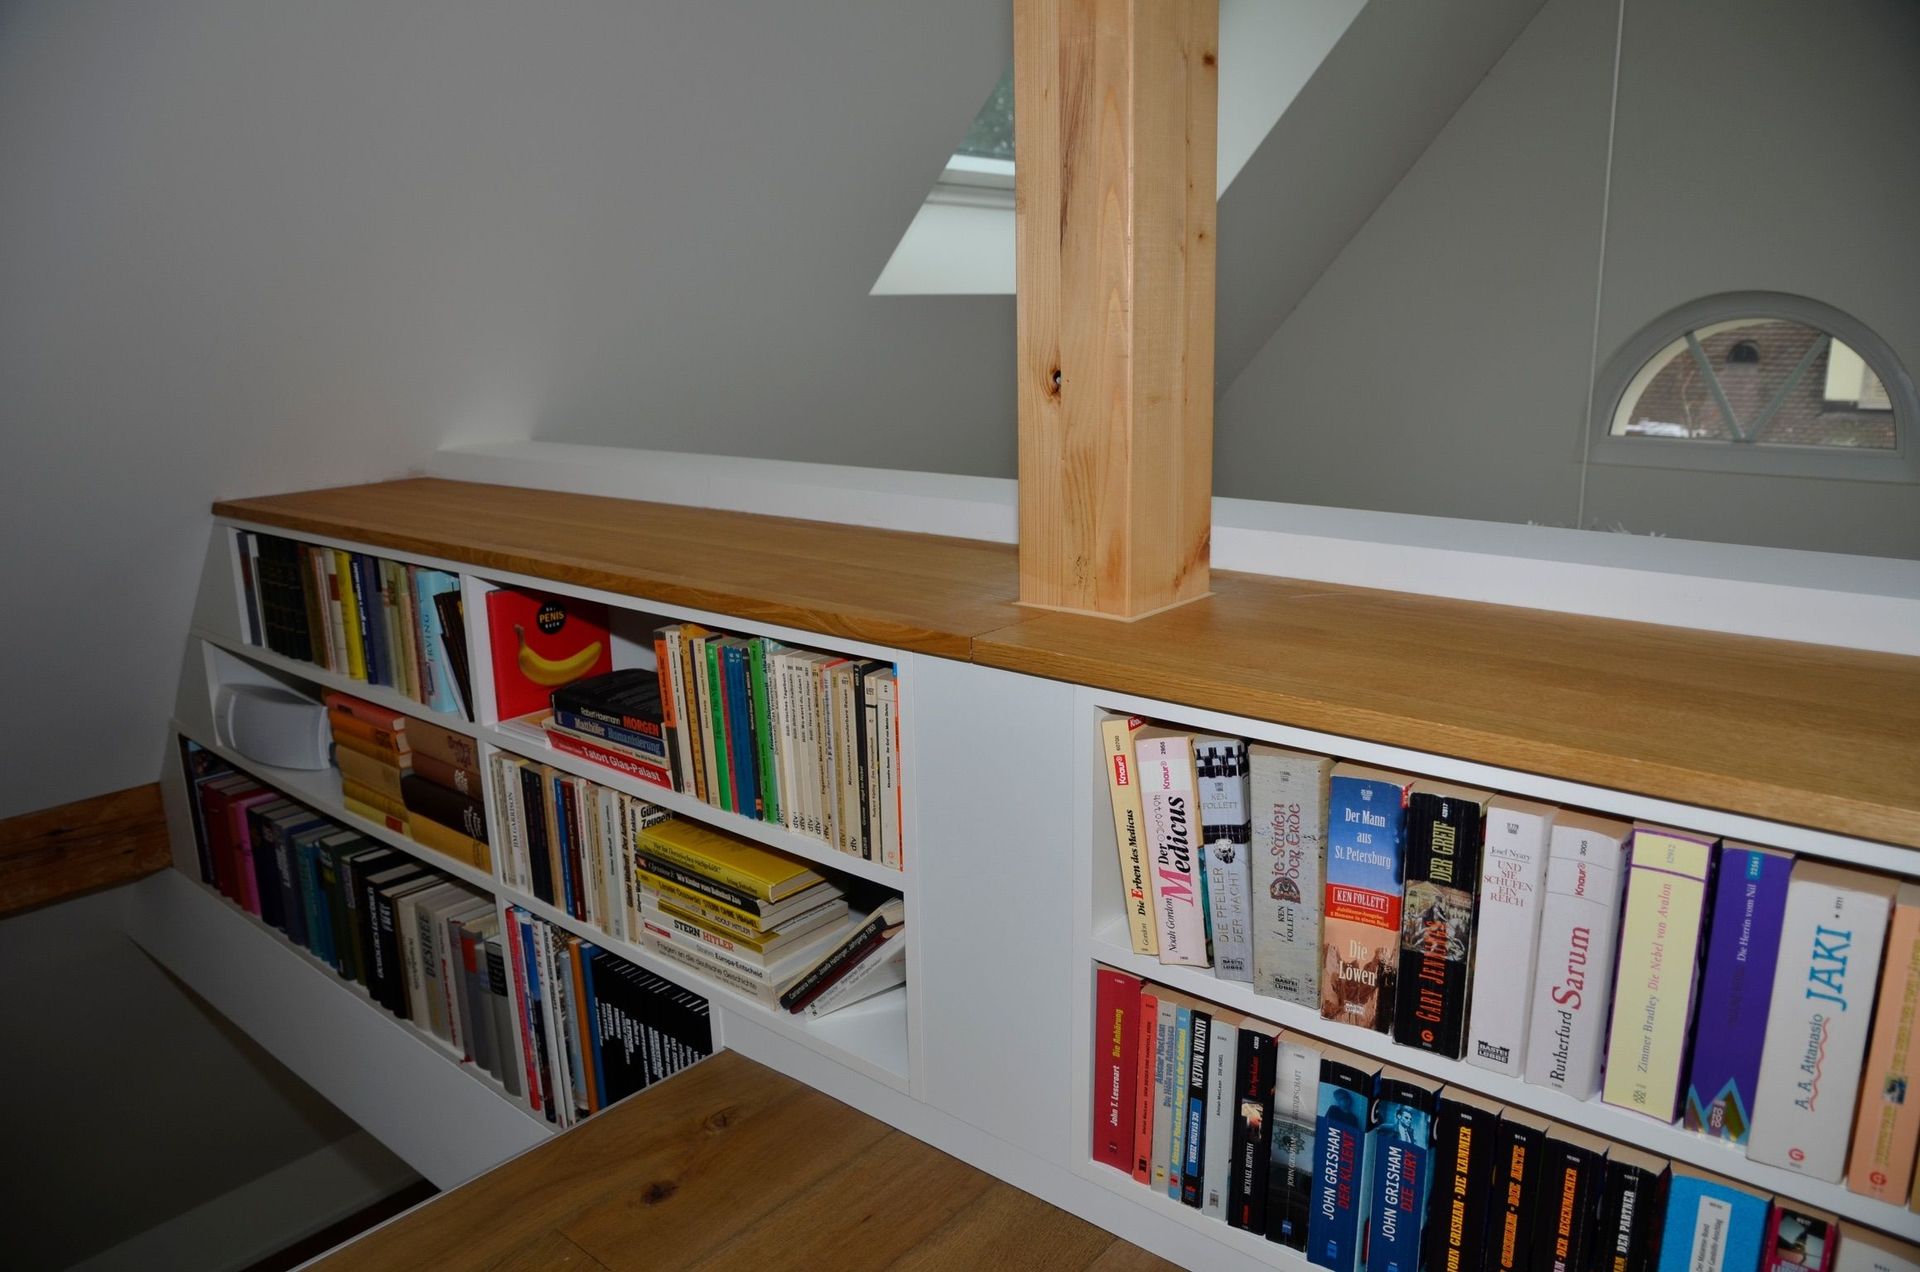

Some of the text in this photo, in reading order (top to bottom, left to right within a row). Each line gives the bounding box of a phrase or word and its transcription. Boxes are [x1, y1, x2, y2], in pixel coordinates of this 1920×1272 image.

[539, 612, 564, 623] PENIS
[623, 716, 658, 737] MORGEN
[582, 747, 608, 764] Tatort
[610, 756, 660, 782] Glas-Palast
[1202, 801, 1238, 810] FOLLETT
[1212, 792, 1228, 800] KEN
[1127, 810, 1137, 848] Medicus
[1345, 808, 1386, 828] Der Mann
[1159, 796, 1194, 907] Medicus
[1357, 832, 1372, 845] aus
[1132, 848, 1140, 860] des
[1158, 844, 1169, 866] Der
[1335, 846, 1392, 870] St. Petersburg
[1498, 860, 1522, 872] UND
[1131, 859, 1144, 900] Erben
[1484, 875, 1533, 892] SCHUFEN
[1502, 870, 1518, 880] SIE
[1336, 890, 1386, 910] KEN FOLLETT
[1490, 892, 1524, 908] REICH
[1499, 886, 1516, 896] EIN
[1658, 883, 1672, 919] Avalon
[1746, 884, 1757, 899] Nil
[1138, 900, 1146, 916] Die
[1214, 867, 1228, 943] DIE PFEILER
[1229, 871, 1244, 944] DER MACHT
[1744, 902, 1752, 917] vom
[1164, 898, 1178, 953] Noah Gordon
[1287, 908, 1295, 942] FOLLETT
[1416, 820, 1456, 1024] GARY JENNINGS DER GREIF
[1657, 922, 1666, 938] von
[1741, 917, 1751, 944] Herrin
[674, 918, 699, 938] STERN
[703, 931, 734, 953] HITLER
[1350, 940, 1368, 961] Die
[1652, 940, 1664, 971] Nebel
[1736, 944, 1747, 962] Die
[1338, 961, 1376, 987] Löwen
[1806, 925, 1852, 1012] JAKI
[1648, 972, 1659, 992] Die
[1550, 926, 1590, 1082] Rutherfurd Sarum
[1643, 993, 1660, 1033] Bradley
[1112, 1008, 1124, 1057] Die Anhörung
[1158, 1024, 1166, 1056] MacLean
[1194, 1018, 1207, 1052] ALISTAIR
[1638, 1033, 1652, 1074] Zimmer
[1795, 1014, 1824, 1111] A. A. Attanasio
[1111, 1065, 1120, 1100] Lescroart
[1110, 1109, 1118, 1126] John
[1192, 1110, 1200, 1120] ICE
[1190, 1121, 1198, 1142] STATION
[1245, 1142, 1254, 1168] RIDPATH
[1456, 1126, 1472, 1174] KAMMER
[1244, 1170, 1252, 1196] MICHAEL
[1288, 1168, 1296, 1187] JOHN
[1322, 1127, 1341, 1221] JOHN GRISHAM
[1337, 1132, 1356, 1210] DER KLIENT
[1400, 1150, 1417, 1213] DIE JURY
[1382, 1146, 1402, 1242] JOHN GRISHAM
[1454, 1175, 1468, 1196] DIE
[1558, 1167, 1578, 1237] REGENMACHER
[1619, 1190, 1635, 1234] PARTNER
[1450, 1200, 1464, 1247] GRISHAM
[1556, 1238, 1568, 1258] DER
[1616, 1234, 1630, 1254] DER
